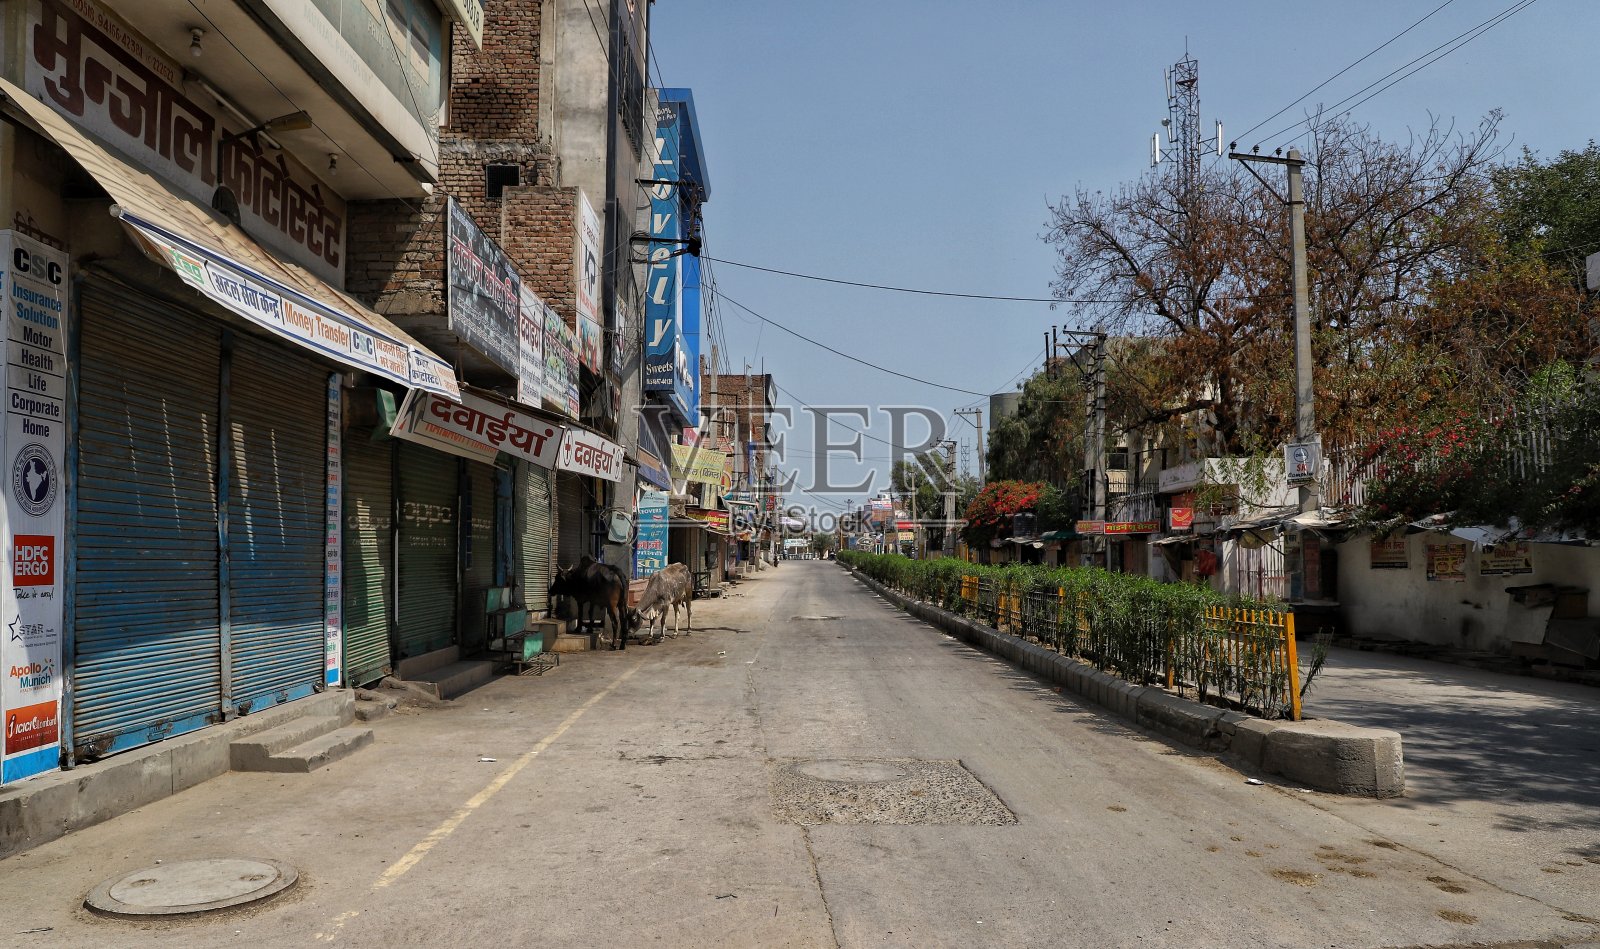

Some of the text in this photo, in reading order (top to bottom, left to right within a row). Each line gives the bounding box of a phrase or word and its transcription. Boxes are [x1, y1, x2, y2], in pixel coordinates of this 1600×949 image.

[649, 137, 673, 347] Lovely
[14, 248, 62, 285] CSC
[13, 281, 62, 312] Insurance
[16, 302, 58, 329] Solution
[284, 302, 348, 348] Money Transfer
[23, 326, 52, 348] Motor
[353, 331, 373, 355] CSC
[21, 349, 53, 371] Health
[646, 361, 673, 375] Sweets
[28, 373, 47, 391] Life
[11, 393, 60, 417] Corporate
[22, 418, 50, 437] Home
[15, 545, 49, 561] HDFC
[14, 561, 49, 576] ERGO
[19, 623, 44, 635] STAR
[10, 662, 42, 679] Apollo
[20, 673, 51, 688] Munich
